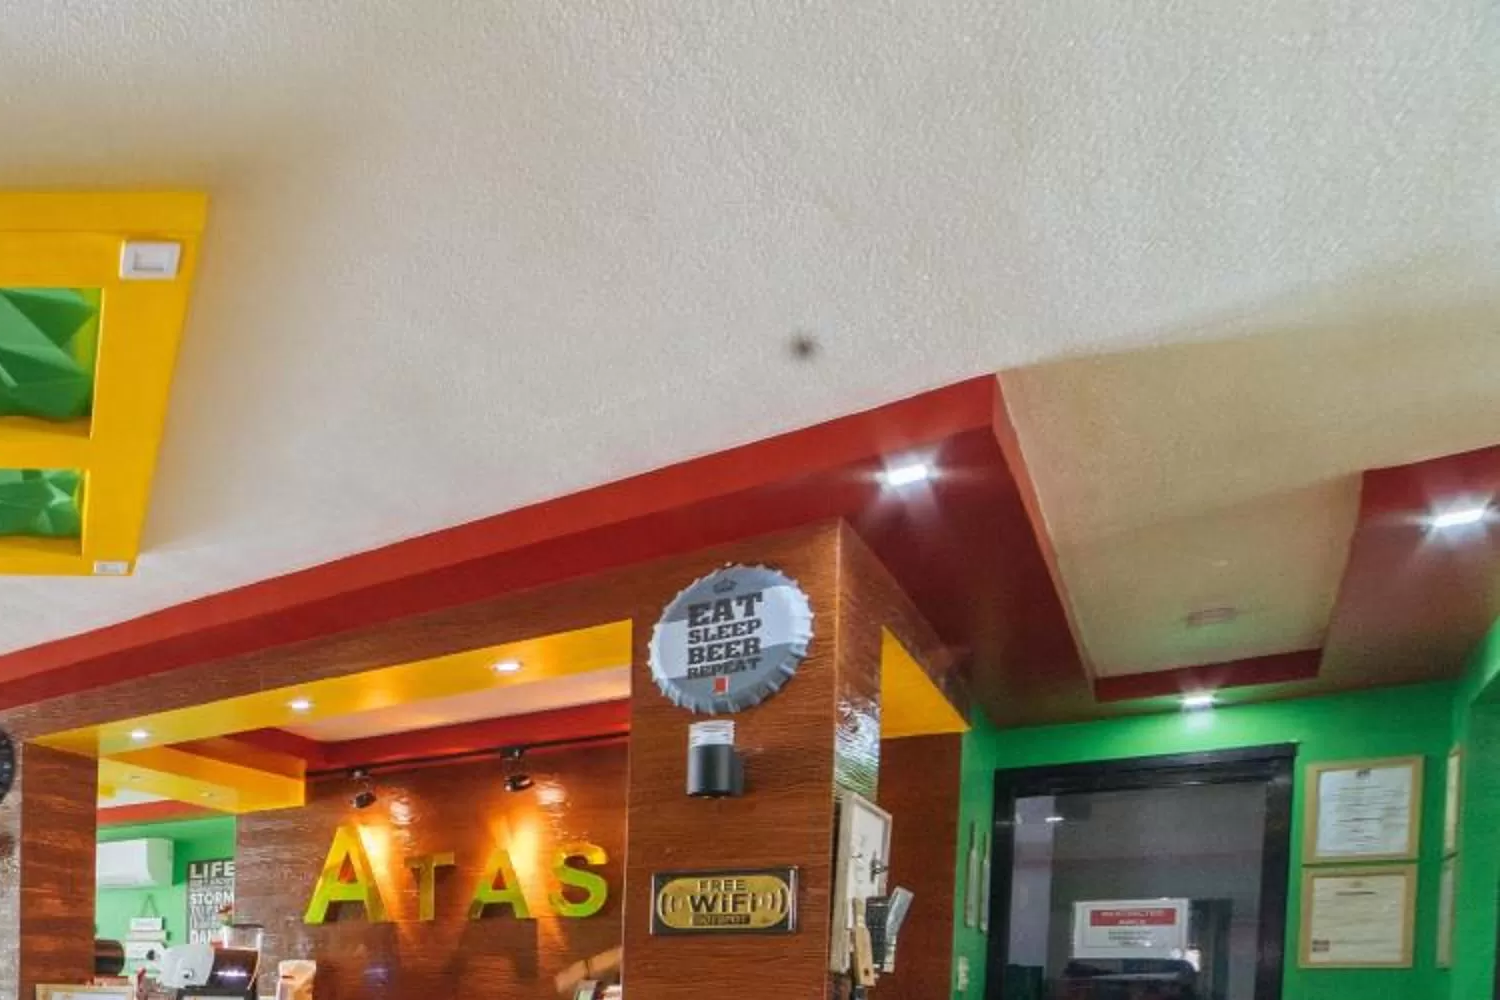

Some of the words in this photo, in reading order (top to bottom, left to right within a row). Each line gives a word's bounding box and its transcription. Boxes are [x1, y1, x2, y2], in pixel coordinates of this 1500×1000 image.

[687, 591, 762, 628] EAT
[687, 619, 761, 645] SLEEP
[687, 637, 761, 666] BEER
[687, 657, 761, 680] REPEAT
[190, 861, 236, 878] LIFE
[699, 879, 745, 891] FREE
[190, 891, 235, 905] STORM
